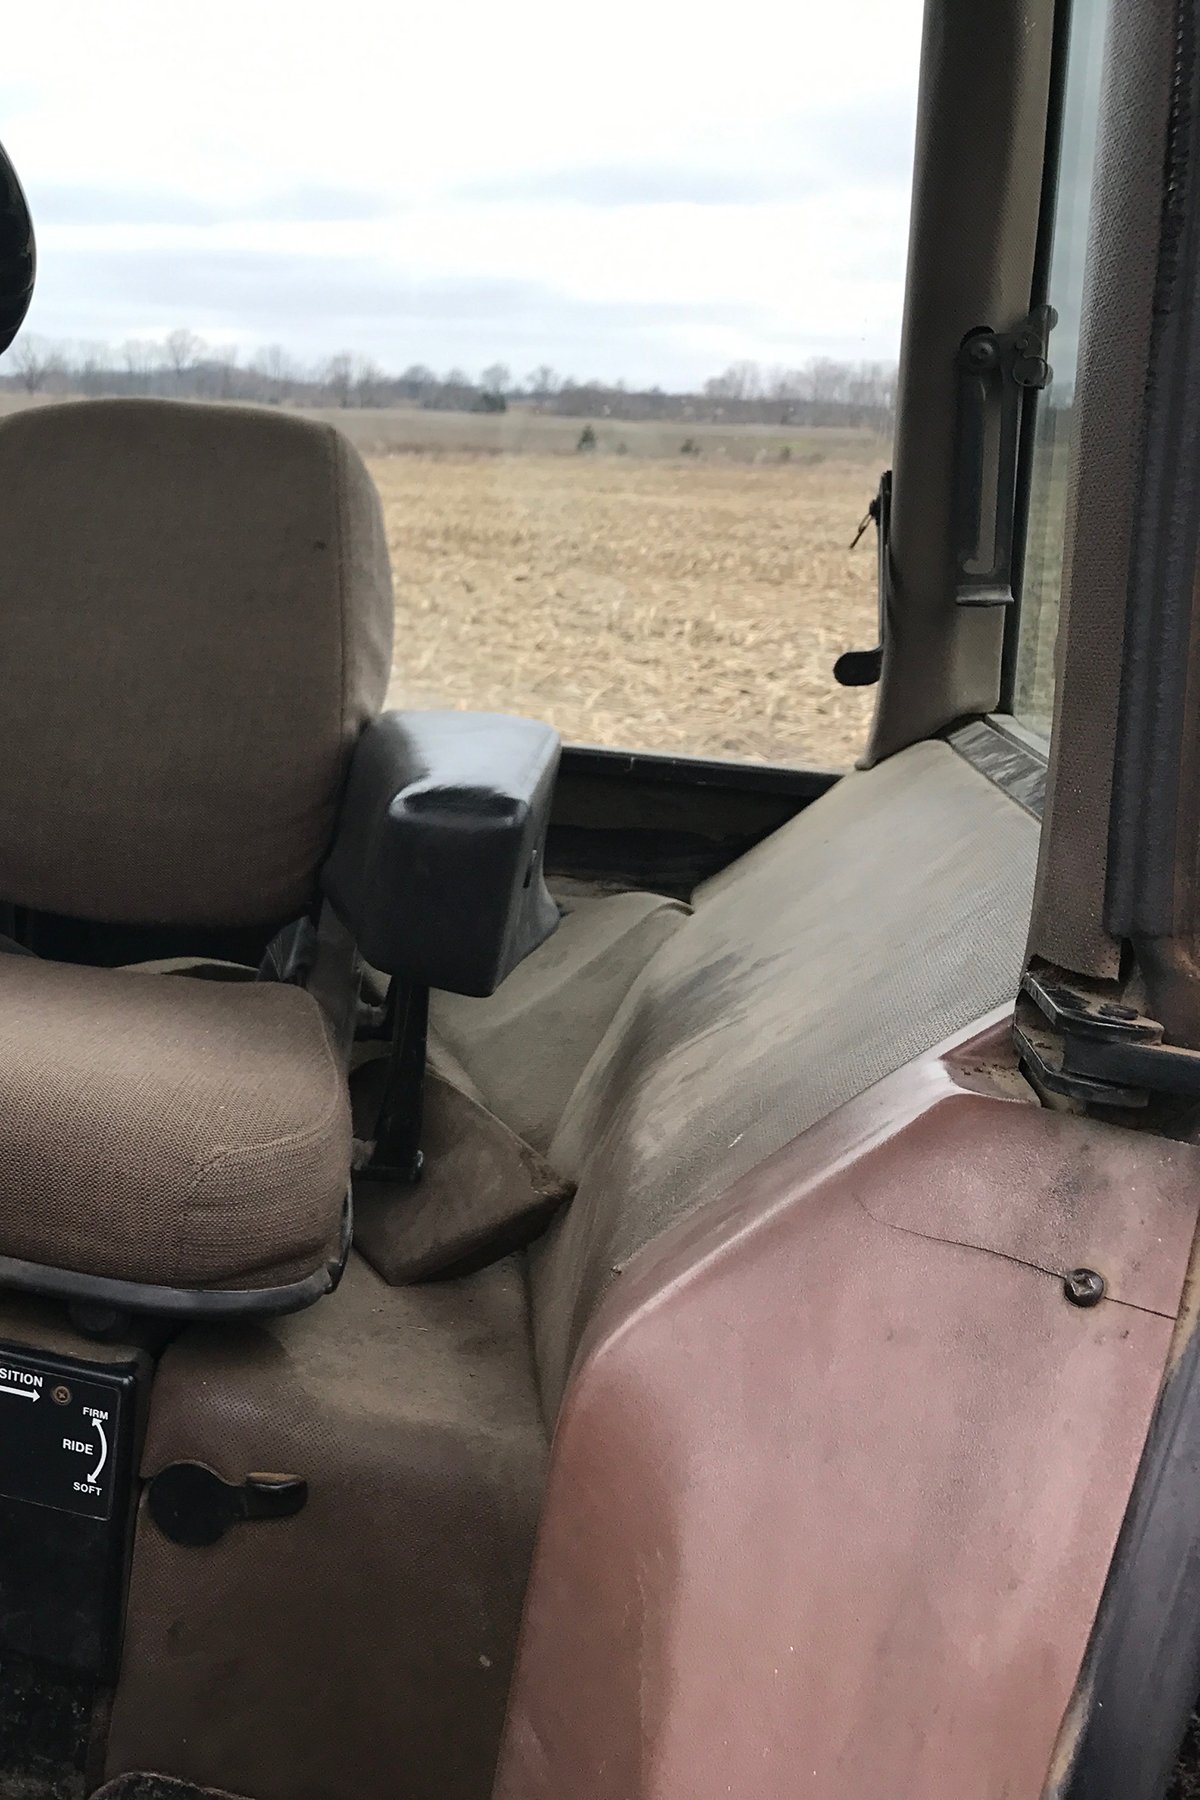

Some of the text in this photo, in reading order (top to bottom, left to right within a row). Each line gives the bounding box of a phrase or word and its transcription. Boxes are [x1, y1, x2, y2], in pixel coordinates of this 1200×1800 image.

[82, 1406, 108, 1420] FIRM
[62, 1438, 94, 1455] RIDE
[72, 1481, 102, 1496] SOFT
